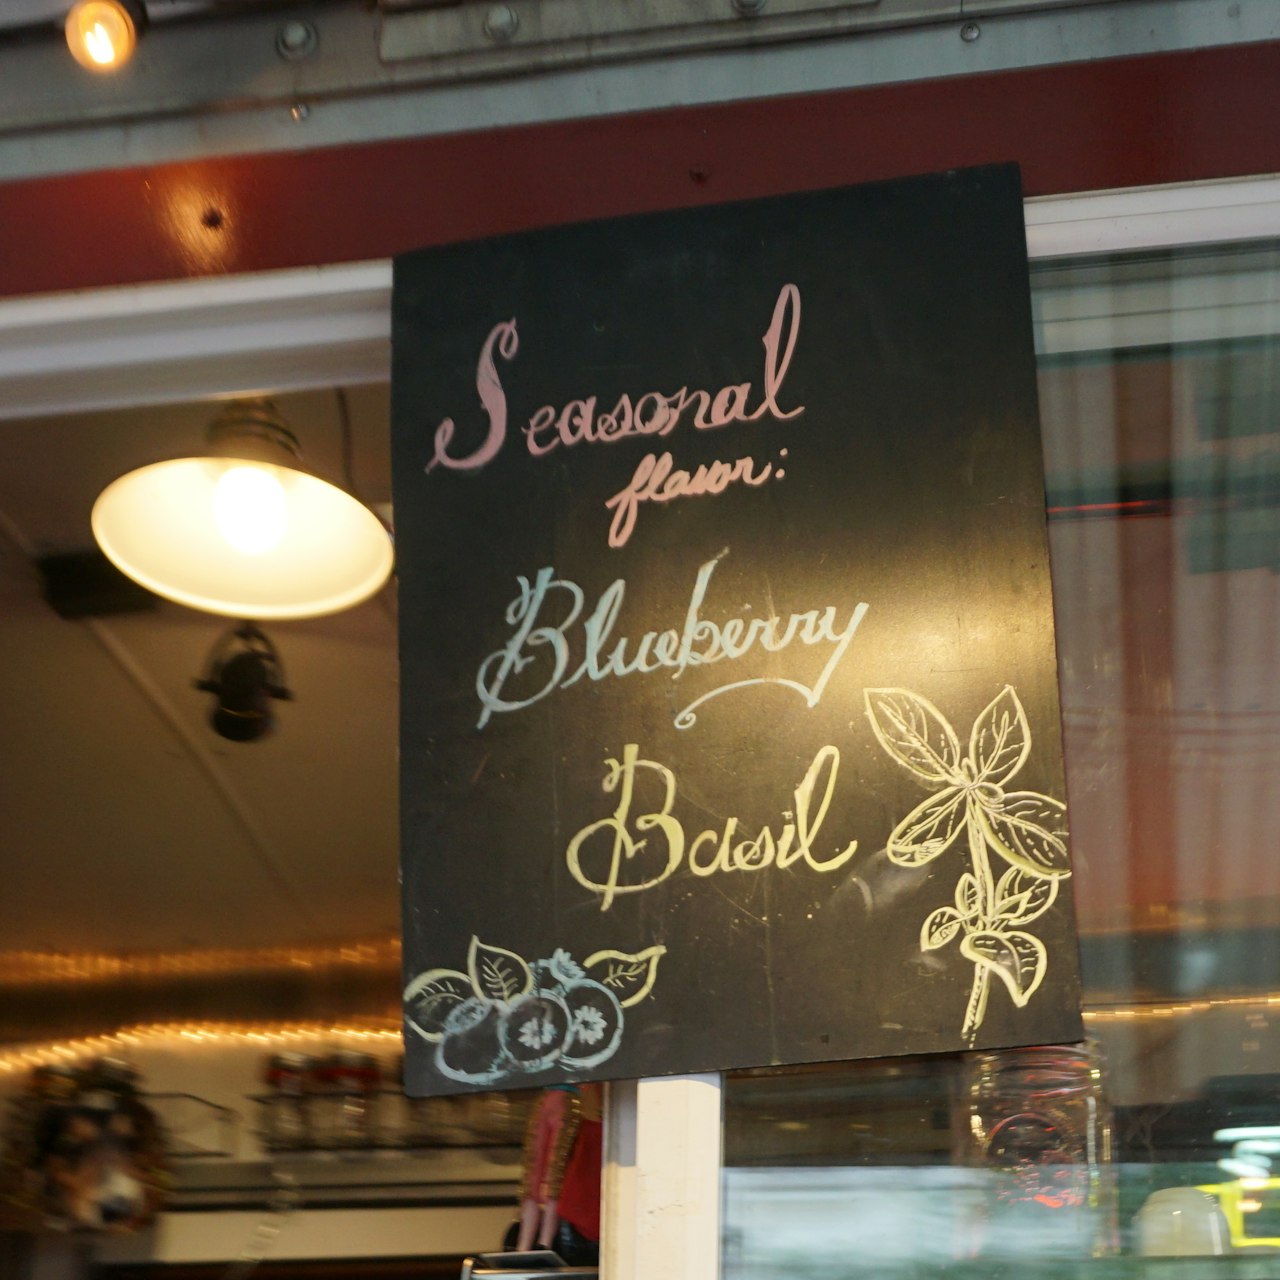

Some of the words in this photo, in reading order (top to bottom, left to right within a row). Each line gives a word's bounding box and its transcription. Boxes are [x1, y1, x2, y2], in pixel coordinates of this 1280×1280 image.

[425, 284, 805, 474] Seasonal
[606, 449, 787, 547] flavor:
[475, 547, 870, 730] Blueberry
[566, 743, 858, 911] Basil
